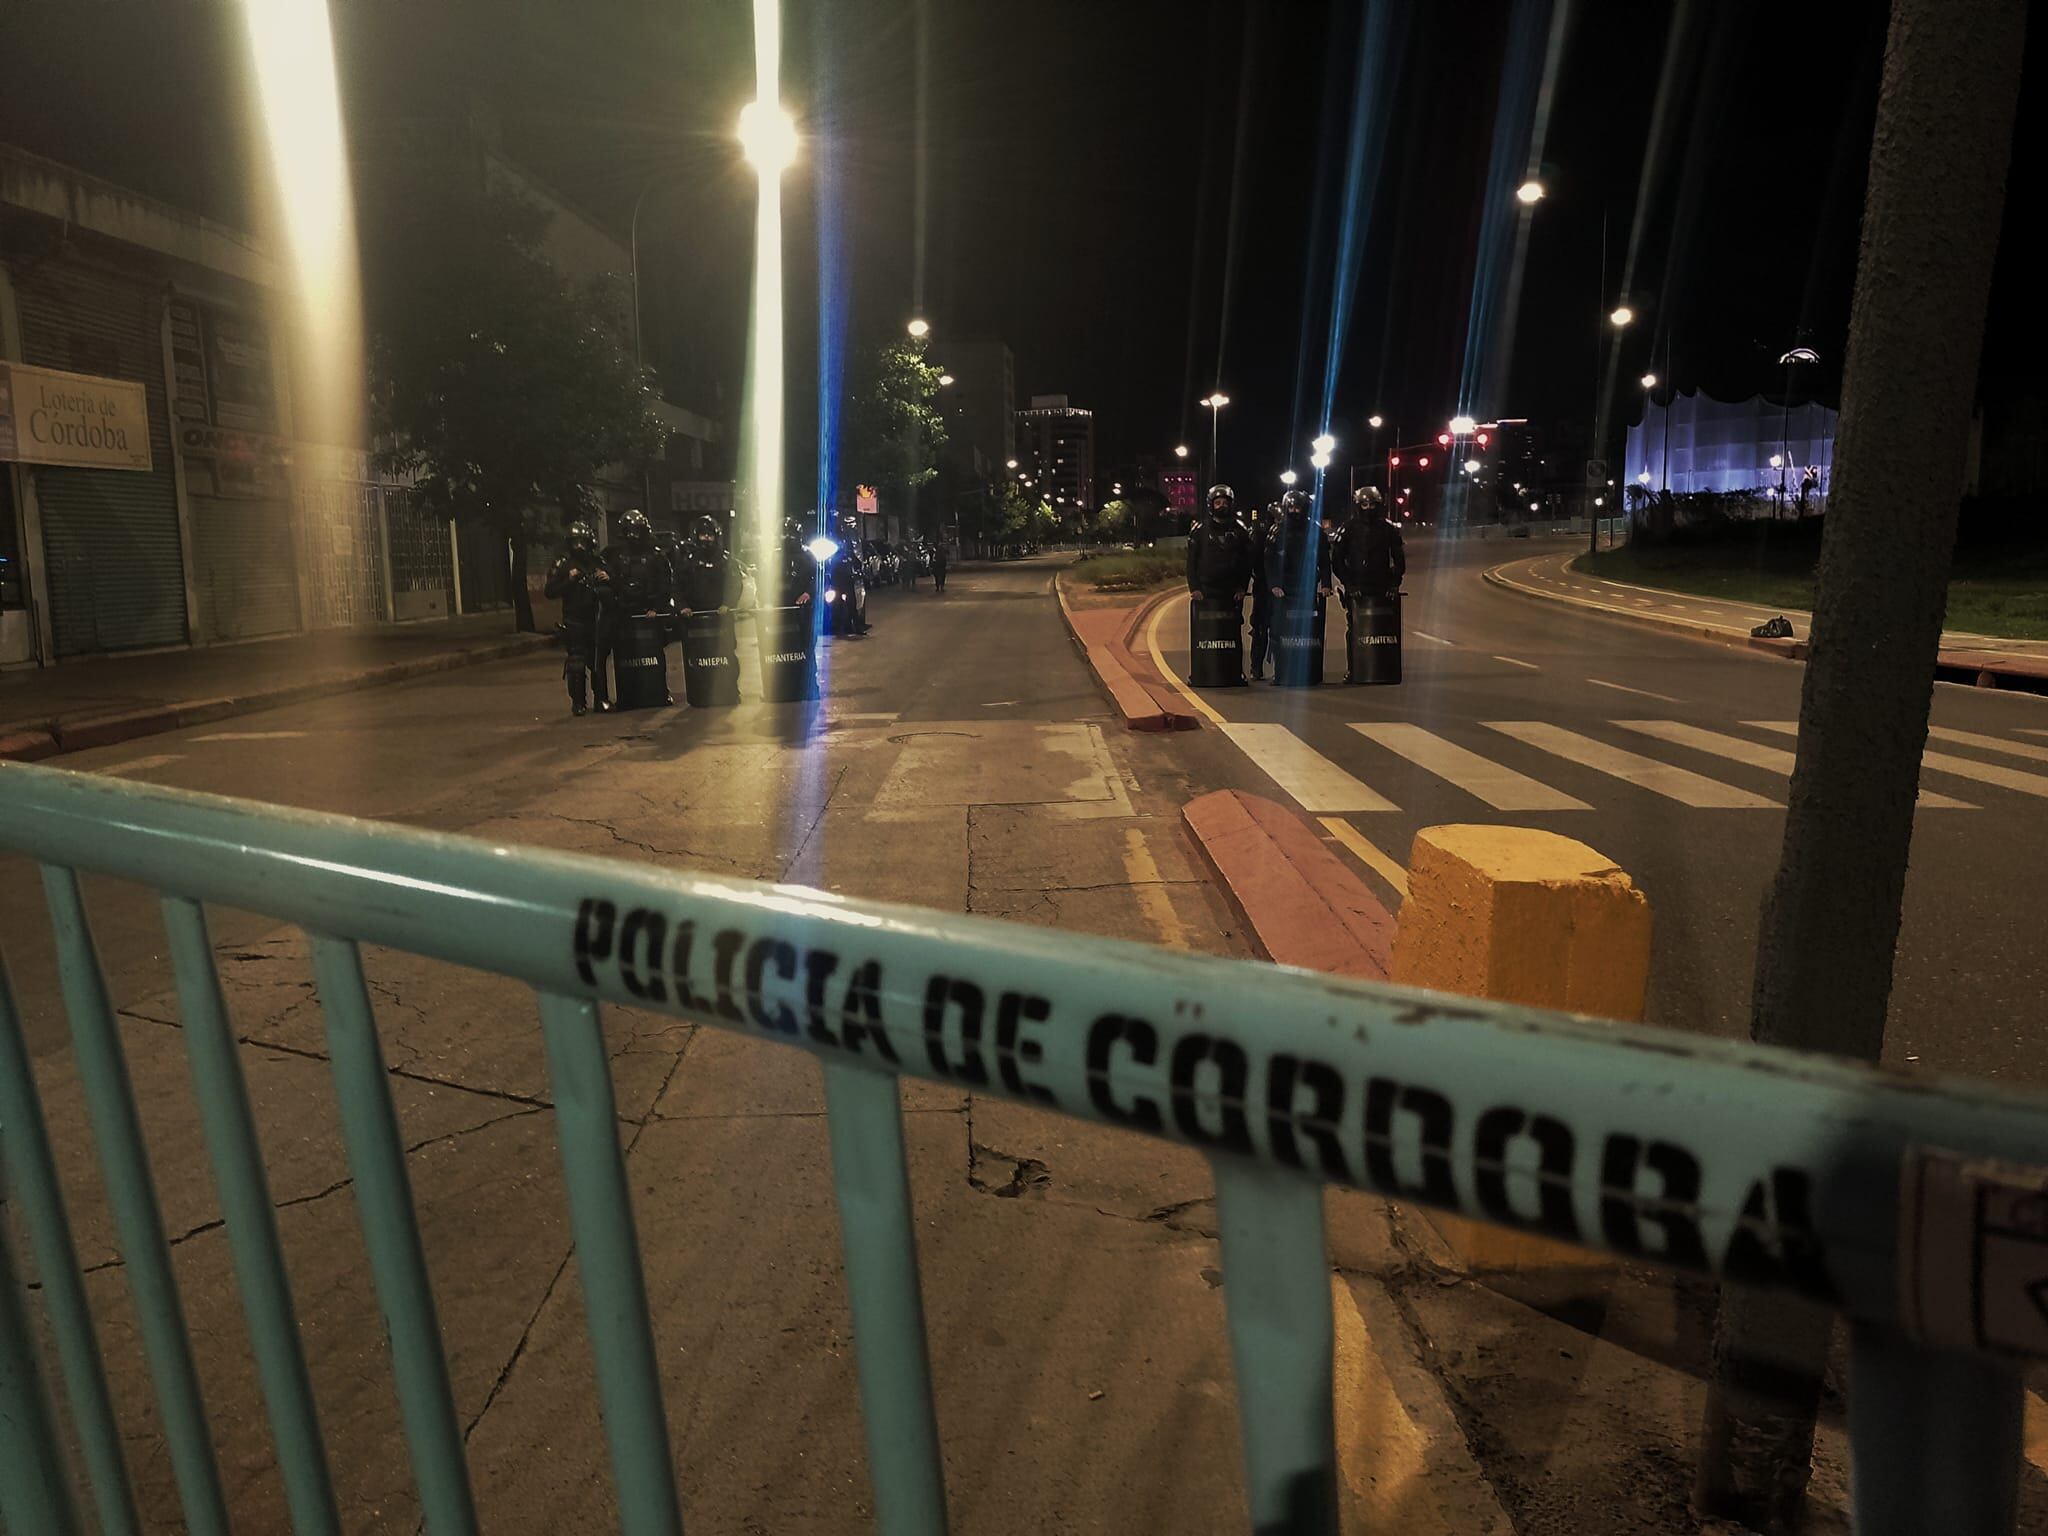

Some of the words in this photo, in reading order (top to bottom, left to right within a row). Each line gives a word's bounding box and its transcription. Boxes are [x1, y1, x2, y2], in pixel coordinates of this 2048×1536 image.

[98, 396, 116, 417] de
[30, 408, 129, 451] Córdoba
[573, 896, 903, 1065] POLICIA
[923, 973, 1060, 1108] DE
[1085, 1012, 1844, 1305] CORDOBA
